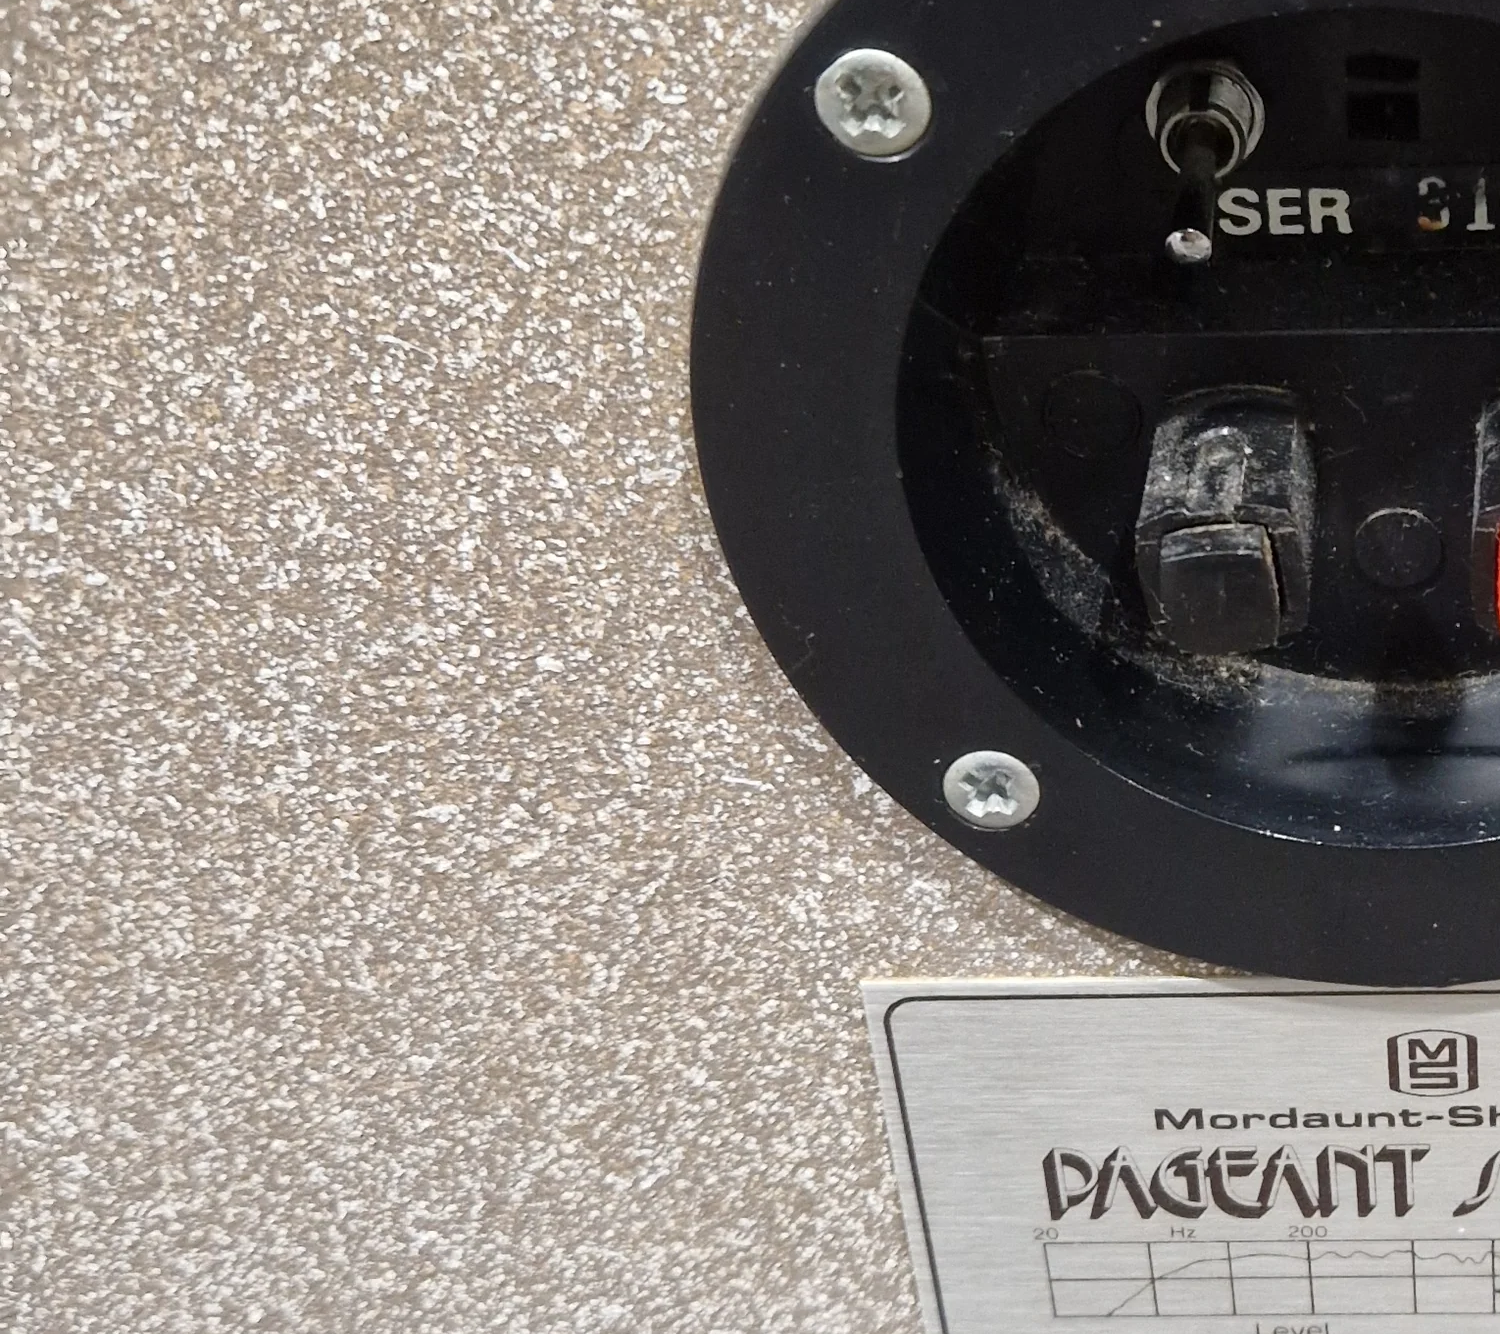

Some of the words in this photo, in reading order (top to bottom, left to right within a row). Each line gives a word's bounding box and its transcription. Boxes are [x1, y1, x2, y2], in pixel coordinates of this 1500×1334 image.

[1217, 187, 1354, 236] SER
[1041, 1143, 1431, 1221] PAGEANT
[1033, 1228, 1060, 1241] 20
[1170, 1225, 1197, 1240] Hz
[1287, 1224, 1328, 1239] 200
